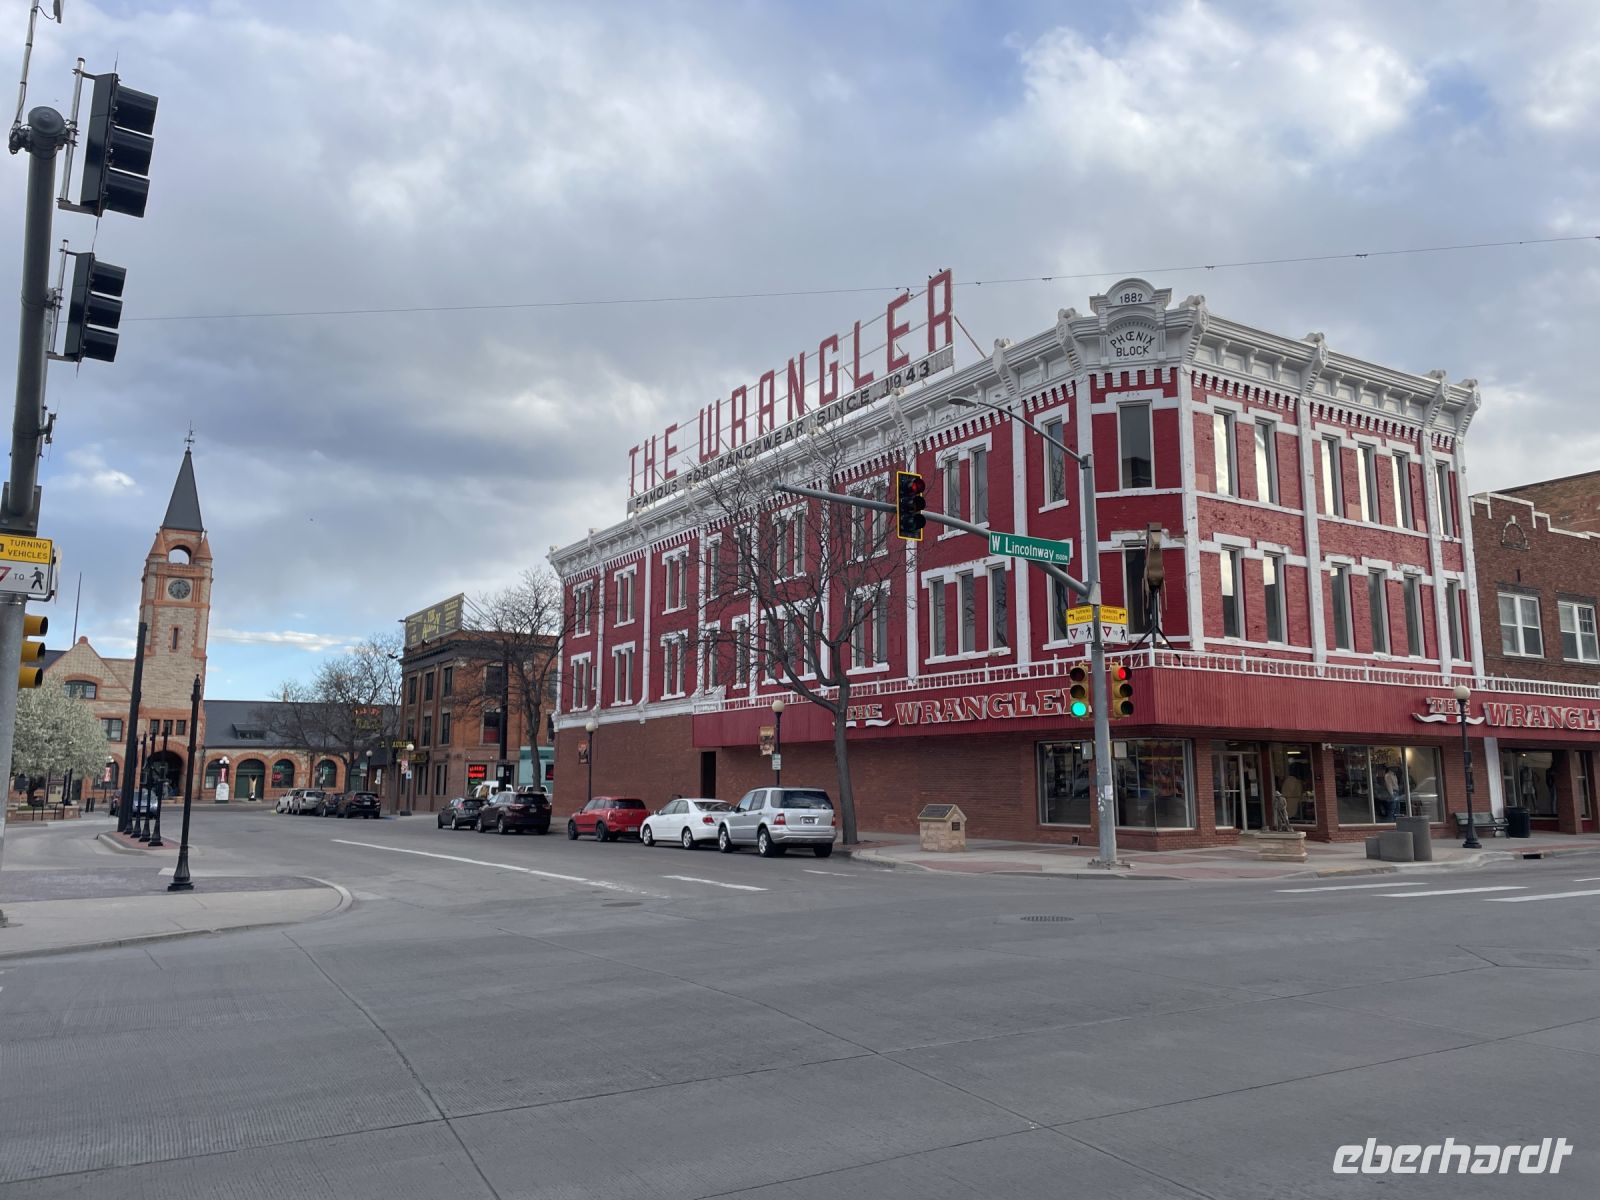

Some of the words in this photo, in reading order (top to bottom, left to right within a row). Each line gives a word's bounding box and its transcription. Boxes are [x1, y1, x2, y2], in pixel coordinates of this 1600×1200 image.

[1120, 292, 1143, 304] 1882
[1110, 331, 1155, 349] PHŒNIX
[1116, 345, 1149, 357] BLOCK
[629, 424, 677, 497] THE
[699, 268, 952, 464] WRANGLER
[636, 480, 678, 508] FAMOUS
[686, 468, 709, 483] FOR
[816, 389, 870, 426] SINCE
[10, 539, 48, 549] TURNING
[992, 534, 1001, 552] W
[1005, 536, 1054, 560] Lincolnway
[7, 549, 48, 560] VEHICLES
[14, 573, 25, 581] TO
[1483, 702, 1600, 731] WRANGL
